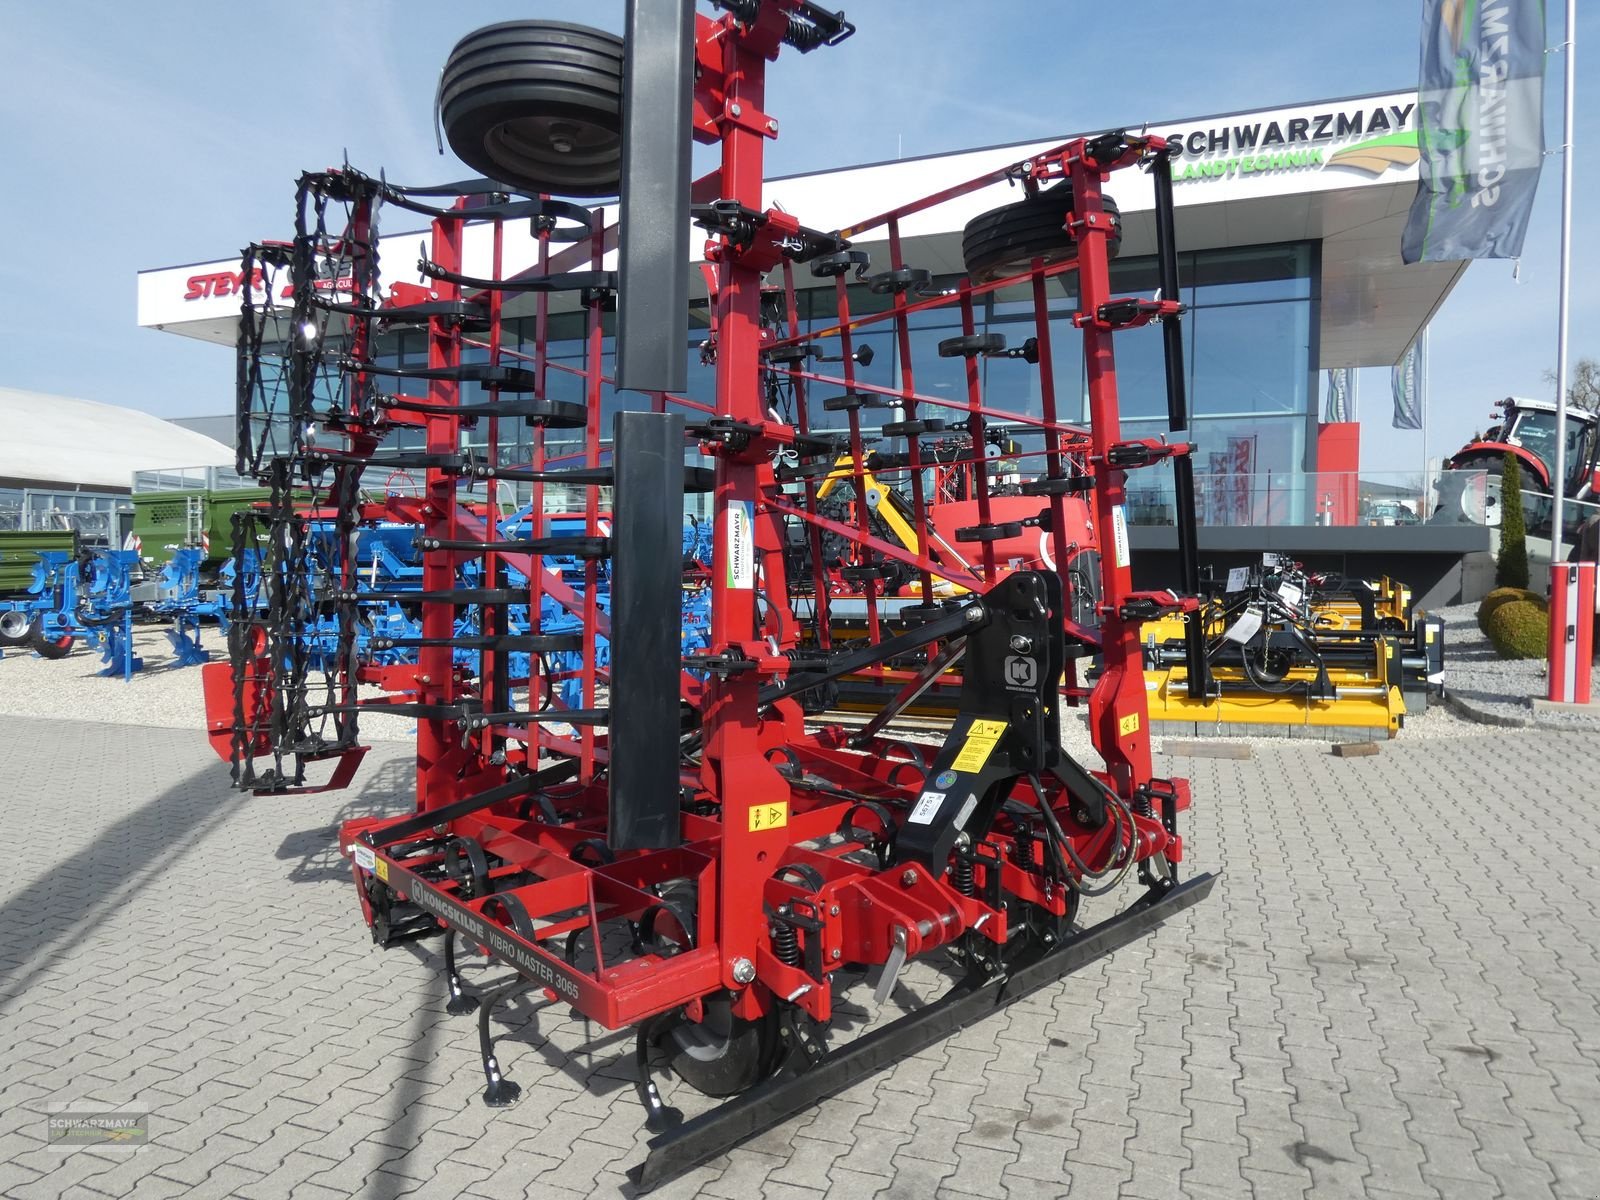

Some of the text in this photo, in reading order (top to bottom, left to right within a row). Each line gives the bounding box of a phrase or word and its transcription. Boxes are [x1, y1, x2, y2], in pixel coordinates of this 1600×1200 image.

[1172, 148, 1324, 181] LANDTECHNIK
[733, 513, 741, 580] SCHWARZMAYR
[423, 890, 484, 939] KONGSKILDE
[489, 931, 515, 959] VIBRO
[516, 949, 554, 984] MASTER
[555, 974, 579, 1000] 3065
